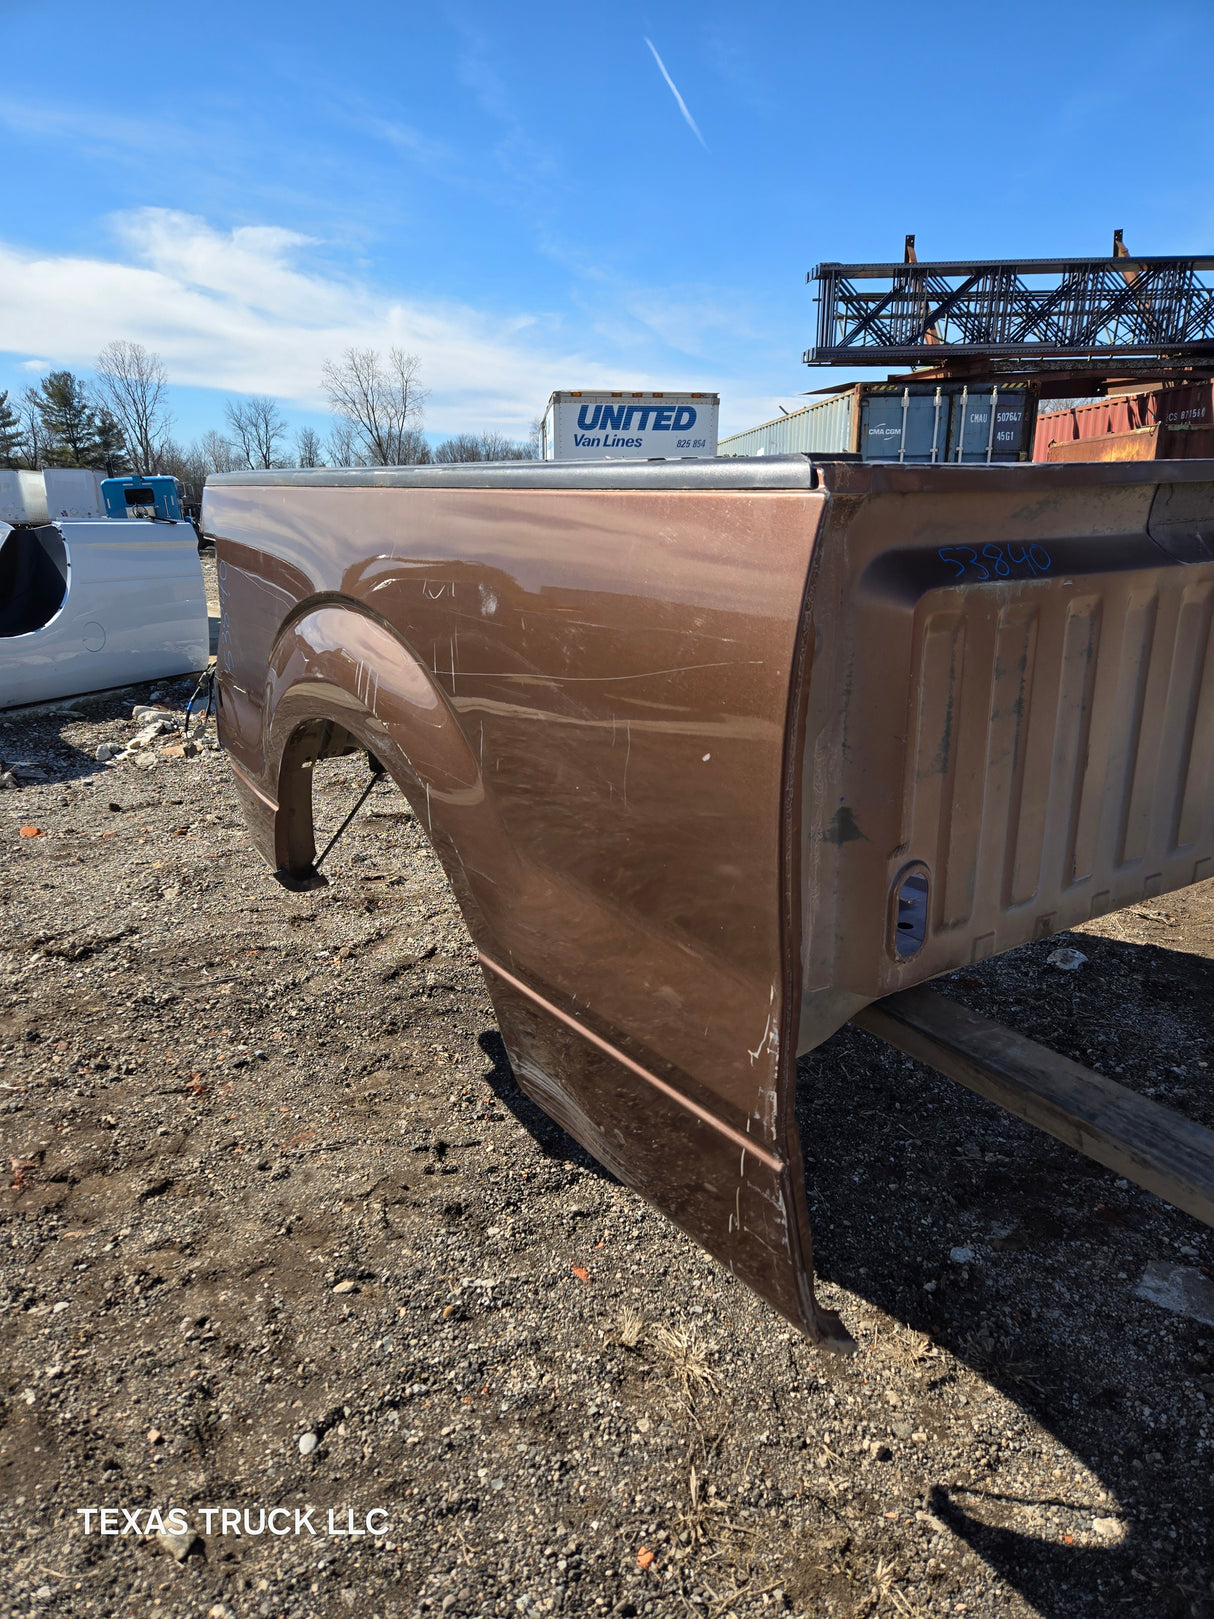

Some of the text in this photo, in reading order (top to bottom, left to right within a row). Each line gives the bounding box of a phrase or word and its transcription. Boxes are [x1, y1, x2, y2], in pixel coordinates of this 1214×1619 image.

[577, 404, 697, 431] UNITED
[970, 413, 988, 423] CMAU
[997, 412, 1022, 423] 507647
[573, 434, 643, 448] Van Lines
[996, 431, 1014, 441] 45G1
[677, 439, 706, 448] 825 854
[938, 543, 1051, 580] 53840
